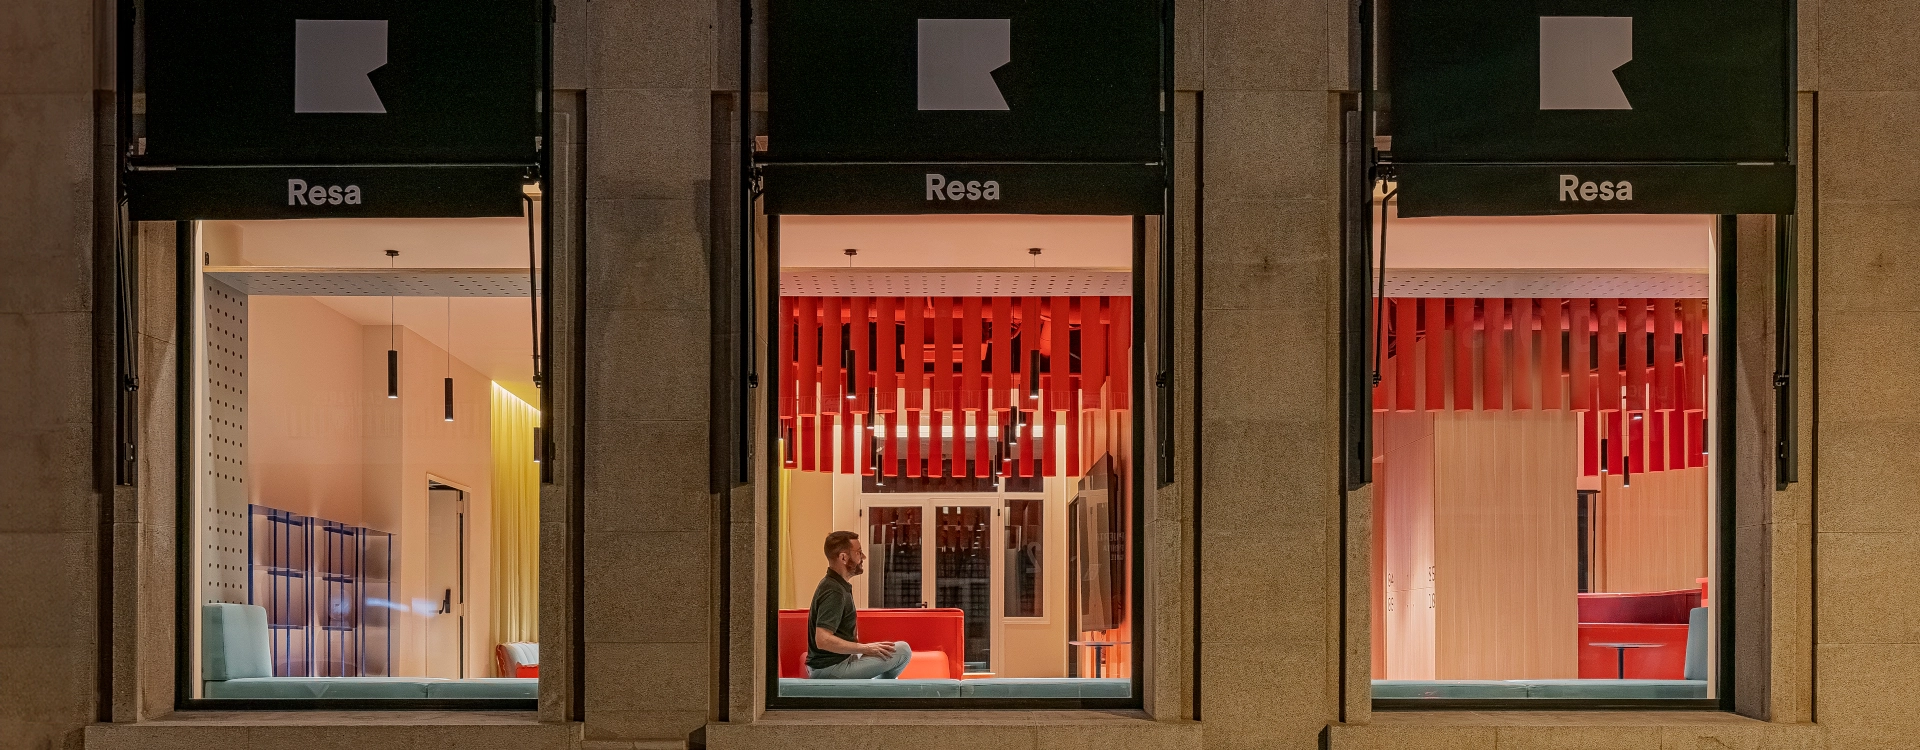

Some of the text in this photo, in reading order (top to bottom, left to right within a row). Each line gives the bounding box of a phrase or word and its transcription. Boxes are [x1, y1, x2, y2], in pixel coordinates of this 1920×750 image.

[288, 179, 361, 205] Resa
[926, 173, 1000, 201] Resa
[1559, 174, 1633, 201] Resa
